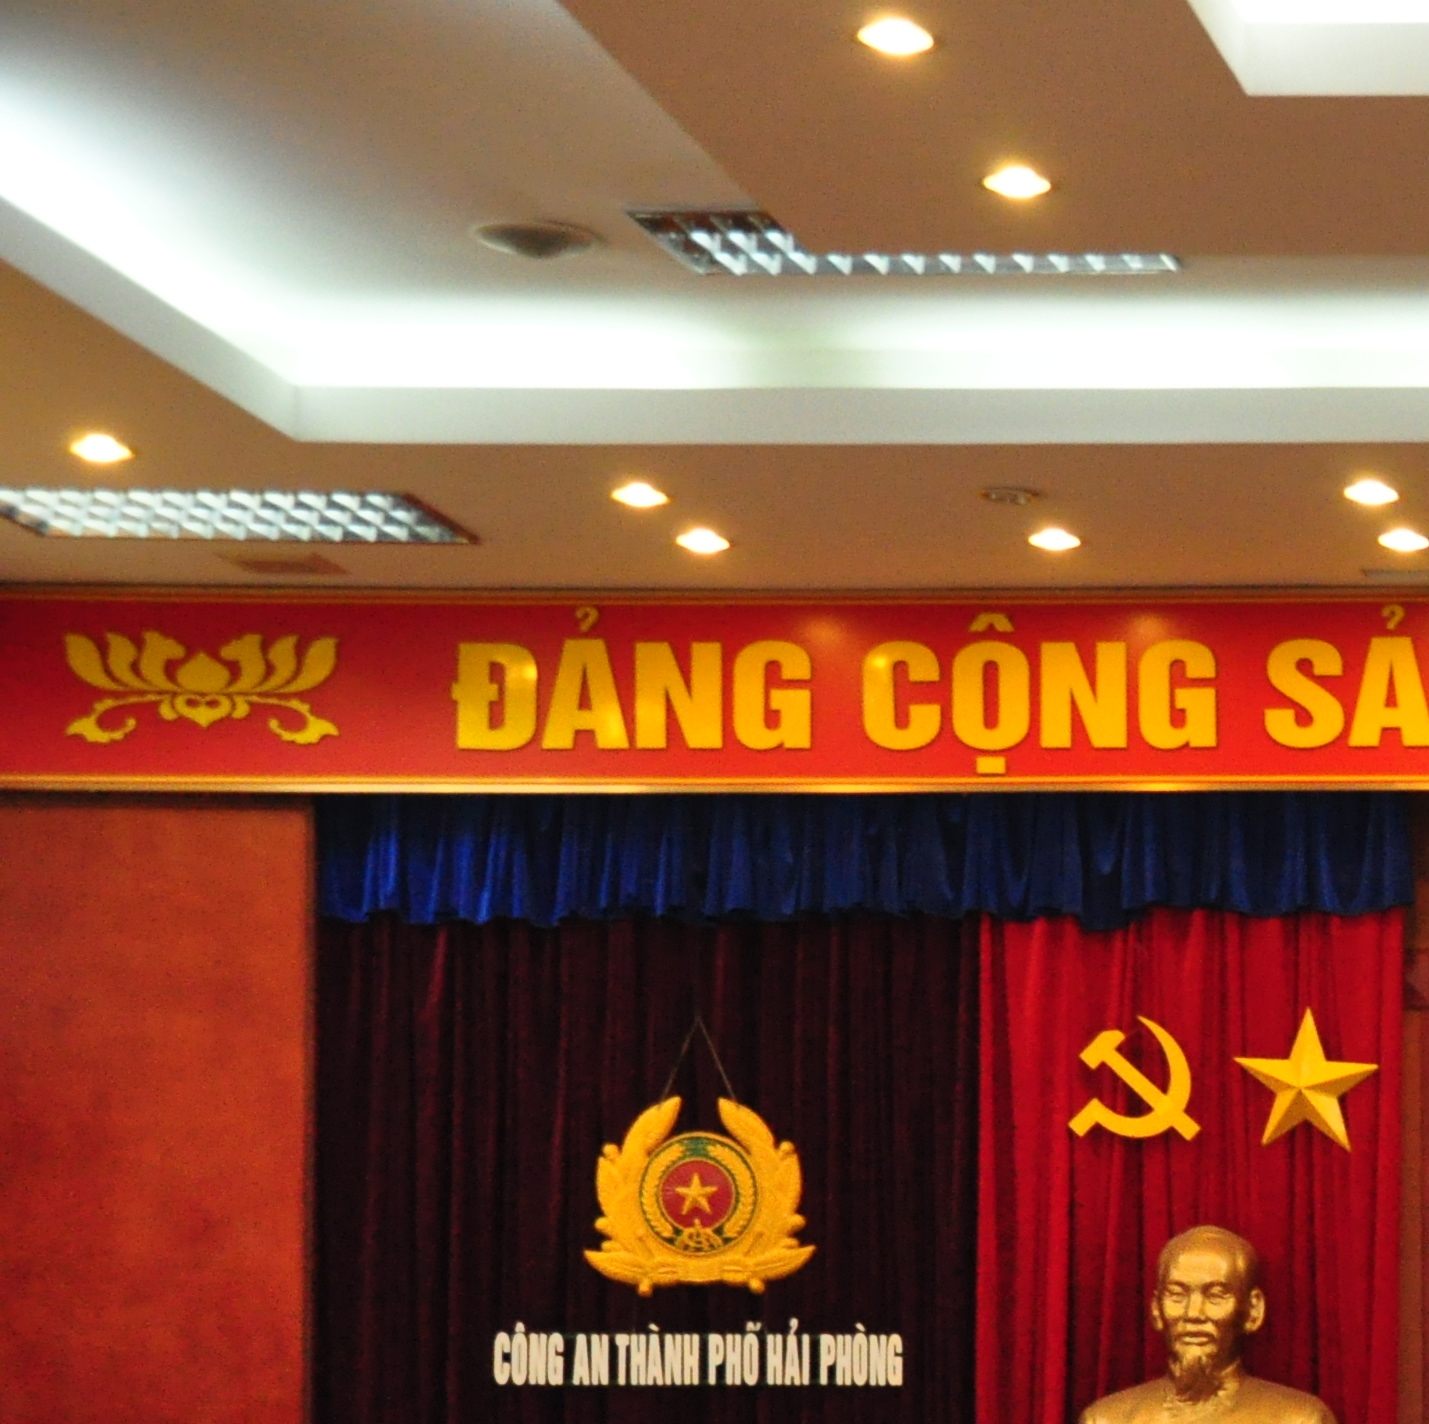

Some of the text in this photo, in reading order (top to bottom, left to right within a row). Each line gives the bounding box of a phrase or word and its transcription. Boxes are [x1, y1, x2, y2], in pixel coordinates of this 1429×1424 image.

[451, 604, 812, 751] ĐẢNG
[860, 612, 1218, 775] CỘNG
[492, 1316, 904, 1387] CÔNG AN THÀNH PHỐ HẢI PHÒNG
